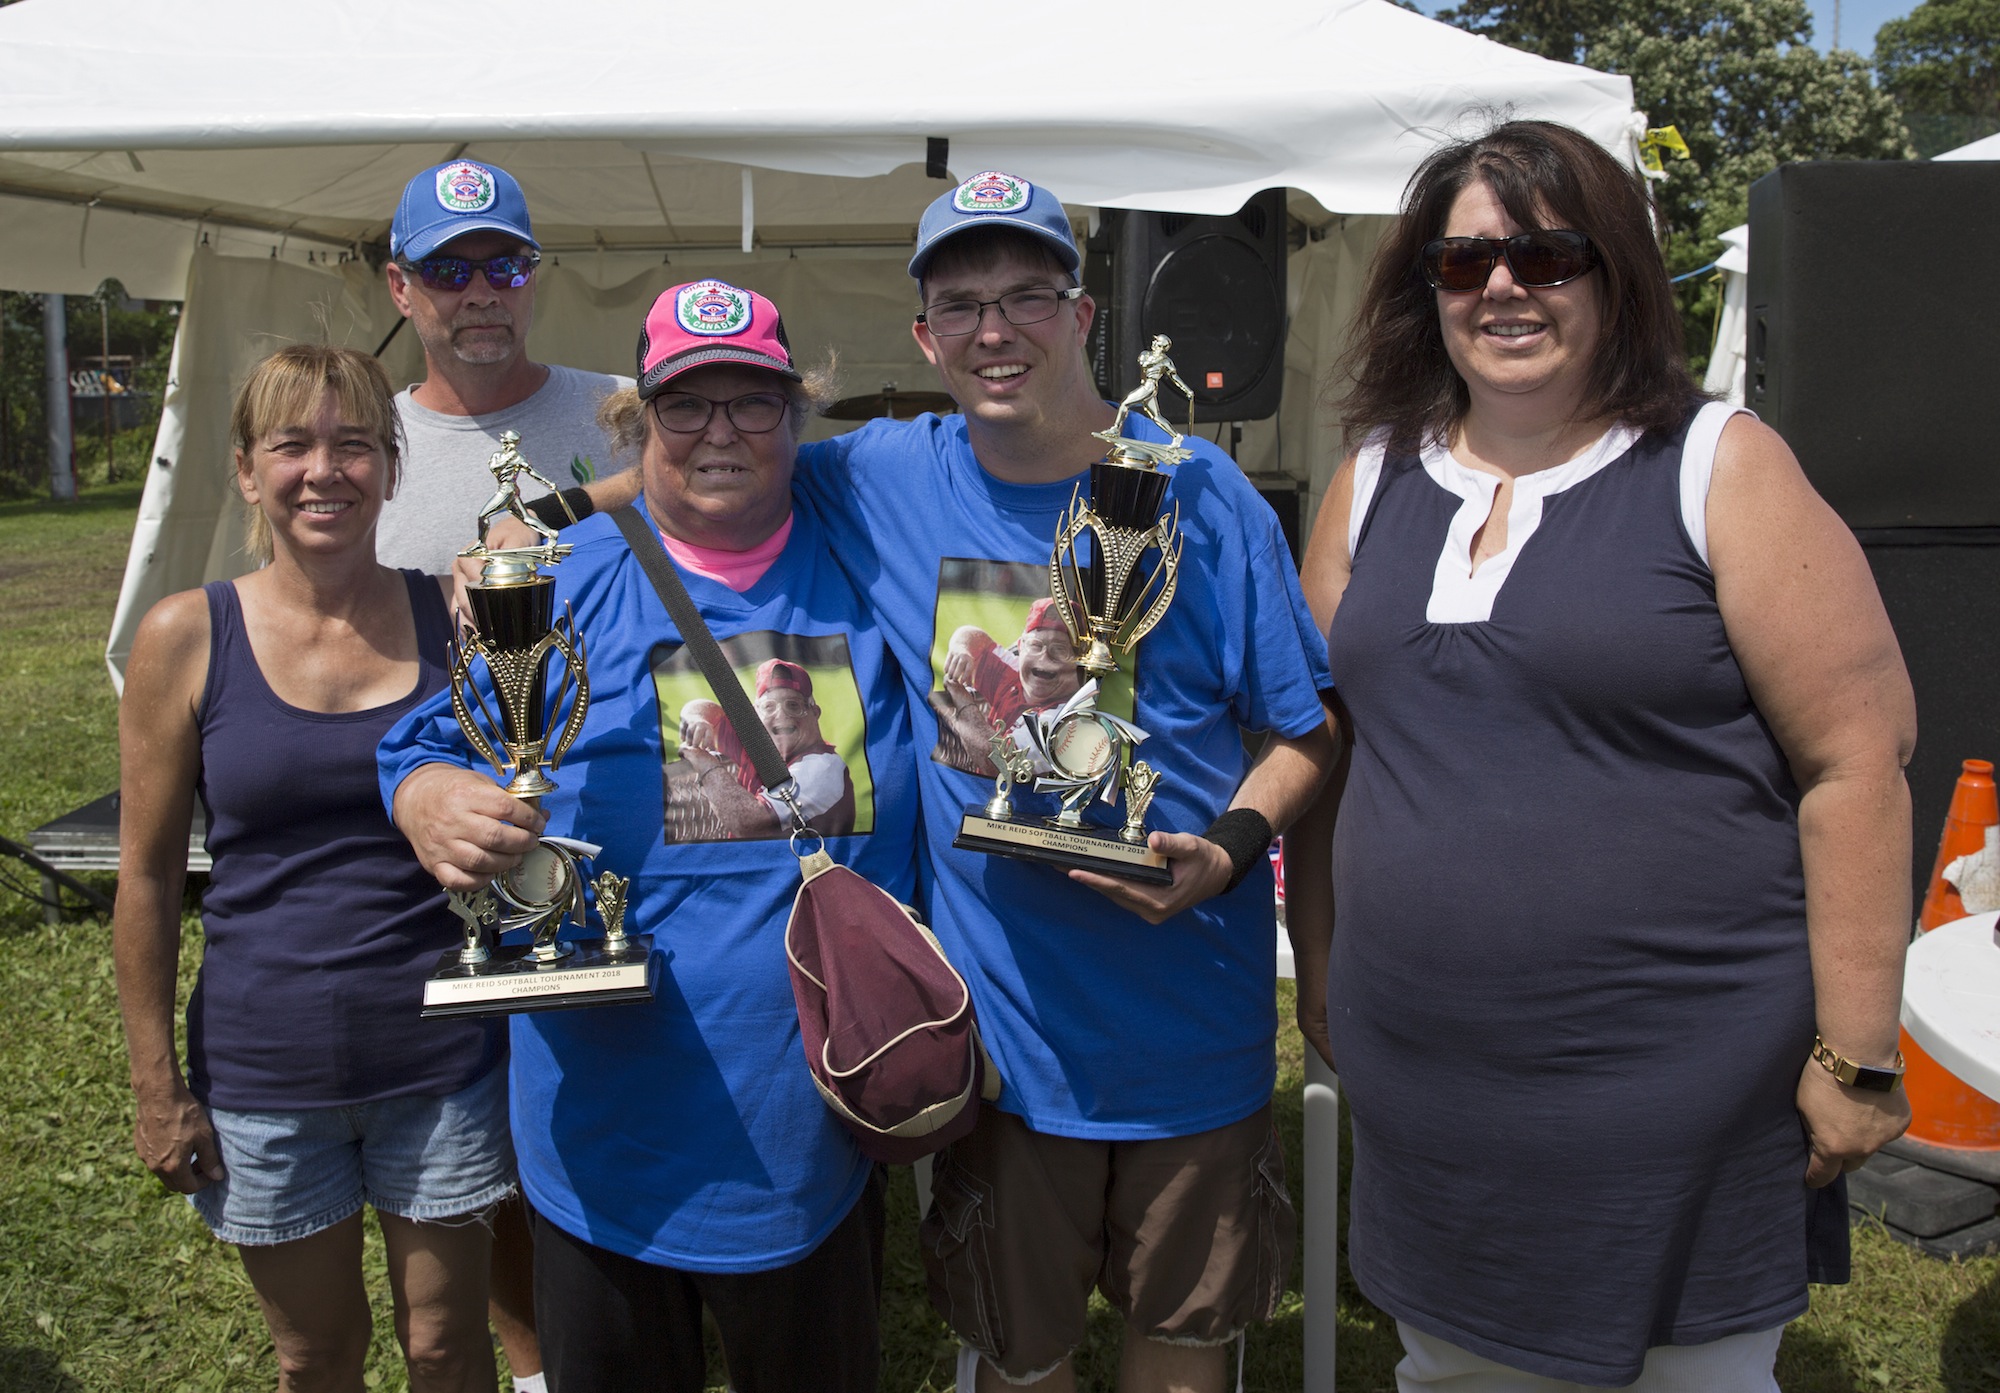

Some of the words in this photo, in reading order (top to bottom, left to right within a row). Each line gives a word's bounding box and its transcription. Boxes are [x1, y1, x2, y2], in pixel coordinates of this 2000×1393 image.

[449, 198, 487, 209] CANADA
[966, 201, 1010, 209] CANADA
[682, 281, 743, 294] CHALLENGER
[692, 320, 735, 330] CANADA
[986, 822, 1006, 831] MIKE
[1008, 826, 1027, 835] REID
[1028, 829, 1068, 842] SOFTBALL
[1069, 836, 1126, 852] TOURNAMENT
[1127, 846, 1146, 855] 2018
[1041, 839, 1089, 853] CHAMPIONS
[452, 981, 473, 990] MIKE
[475, 979, 495, 989] REID
[497, 976, 538, 987] SOFTBALL
[540, 971, 600, 983] TOURNAMENT
[601, 969, 621, 978] 2018
[511, 983, 561, 994] CHAMPIONS
